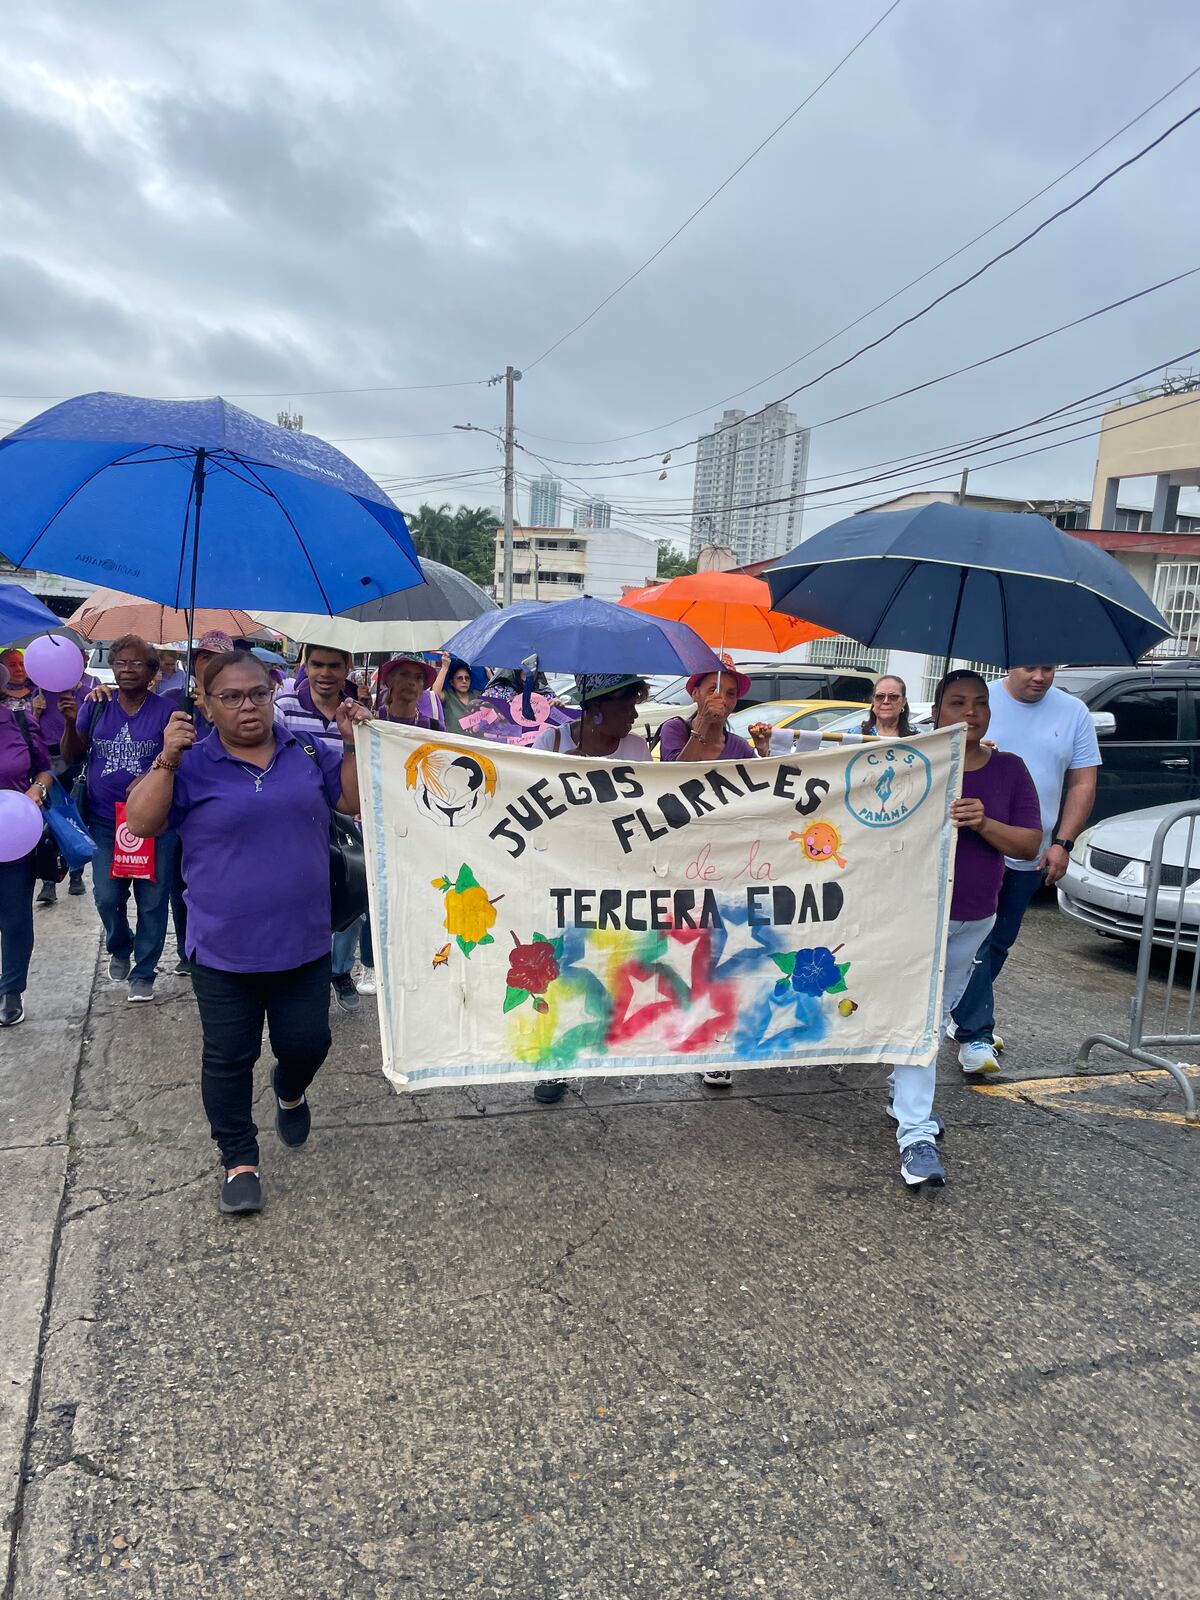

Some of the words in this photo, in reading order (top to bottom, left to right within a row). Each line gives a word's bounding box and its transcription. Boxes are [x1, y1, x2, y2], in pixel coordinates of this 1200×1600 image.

[488, 765, 645, 859] JUEGOS
[611, 763, 830, 854] FLORALES
[859, 802, 909, 822] PANAMÁ
[114, 854, 150, 865] ONWAY
[685, 842, 722, 882] de
[733, 839, 779, 882] la
[550, 887, 725, 931] TERCERA
[746, 881, 845, 927] EDAD
